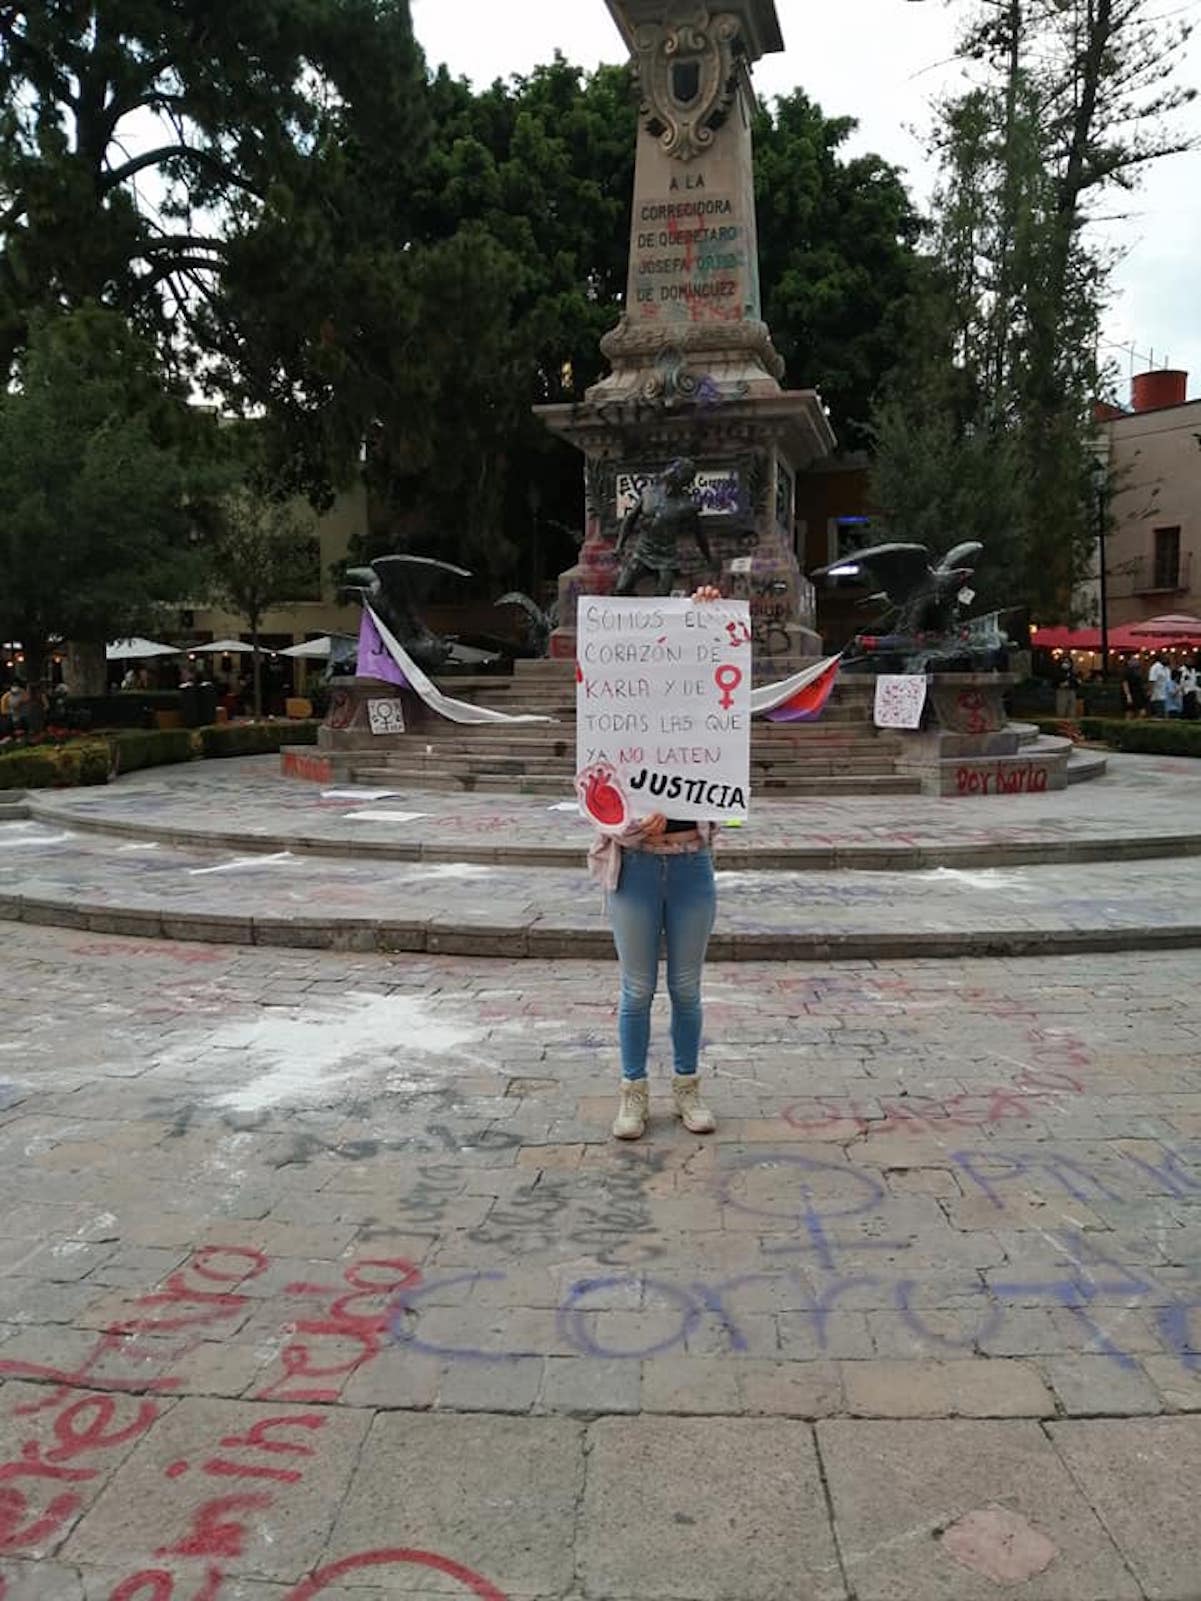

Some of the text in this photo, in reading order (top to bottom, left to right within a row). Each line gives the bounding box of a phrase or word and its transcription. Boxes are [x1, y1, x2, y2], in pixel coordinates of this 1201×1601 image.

[669, 173, 705, 192] A LA
[640, 199, 733, 222] CORREGIDORA
[637, 231, 655, 250] DE
[638, 255, 689, 276] JOSEFA
[636, 286, 654, 303] DE
[586, 606, 708, 632] SOMOS EL
[584, 636, 722, 664] CORAZÓN DE
[585, 679, 706, 699] KARLA Y DE
[585, 713, 743, 735] TODAS LAS QUE
[586, 747, 722, 765] YA NO LATEN
[629, 768, 746, 810] JUSTICIA
